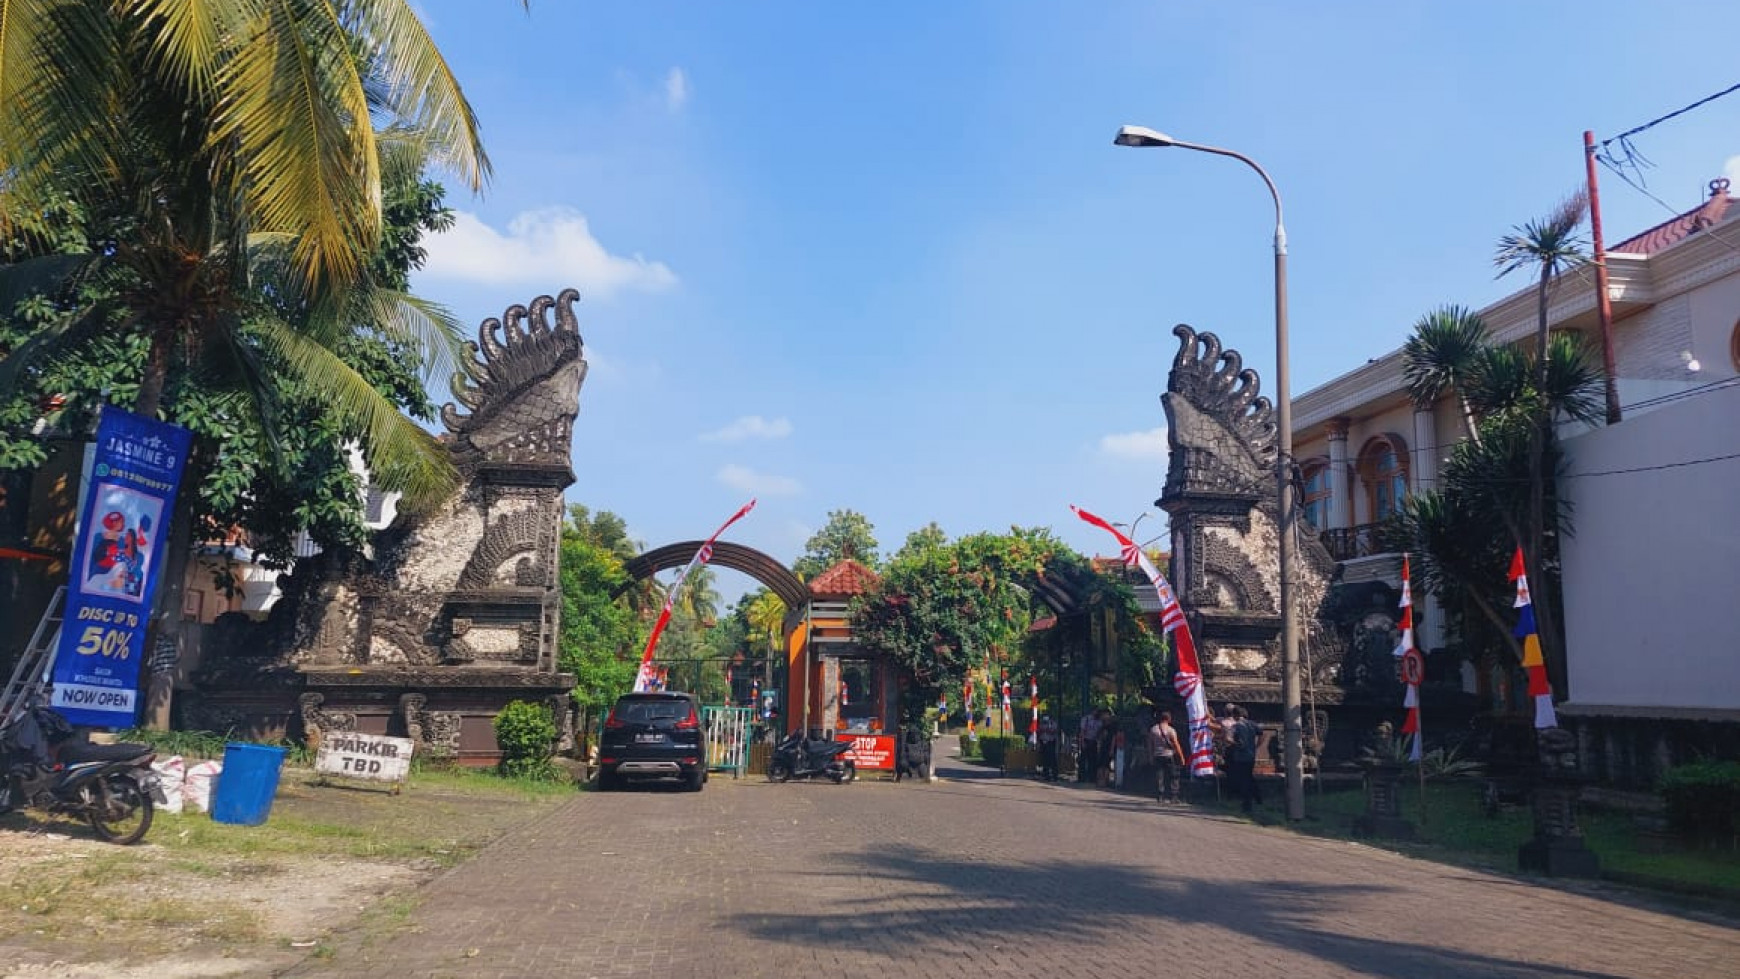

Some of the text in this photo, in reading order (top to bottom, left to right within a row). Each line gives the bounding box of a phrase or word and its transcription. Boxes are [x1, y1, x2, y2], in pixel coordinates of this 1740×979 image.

[106, 437, 176, 469] JASMINE 9
[77, 606, 114, 623] DISC
[76, 626, 132, 660] 50%
[63, 689, 128, 707] NOW OPEN
[331, 738, 398, 758] PARKIR
[852, 737, 877, 751] STOP
[342, 757, 381, 773] TBD
